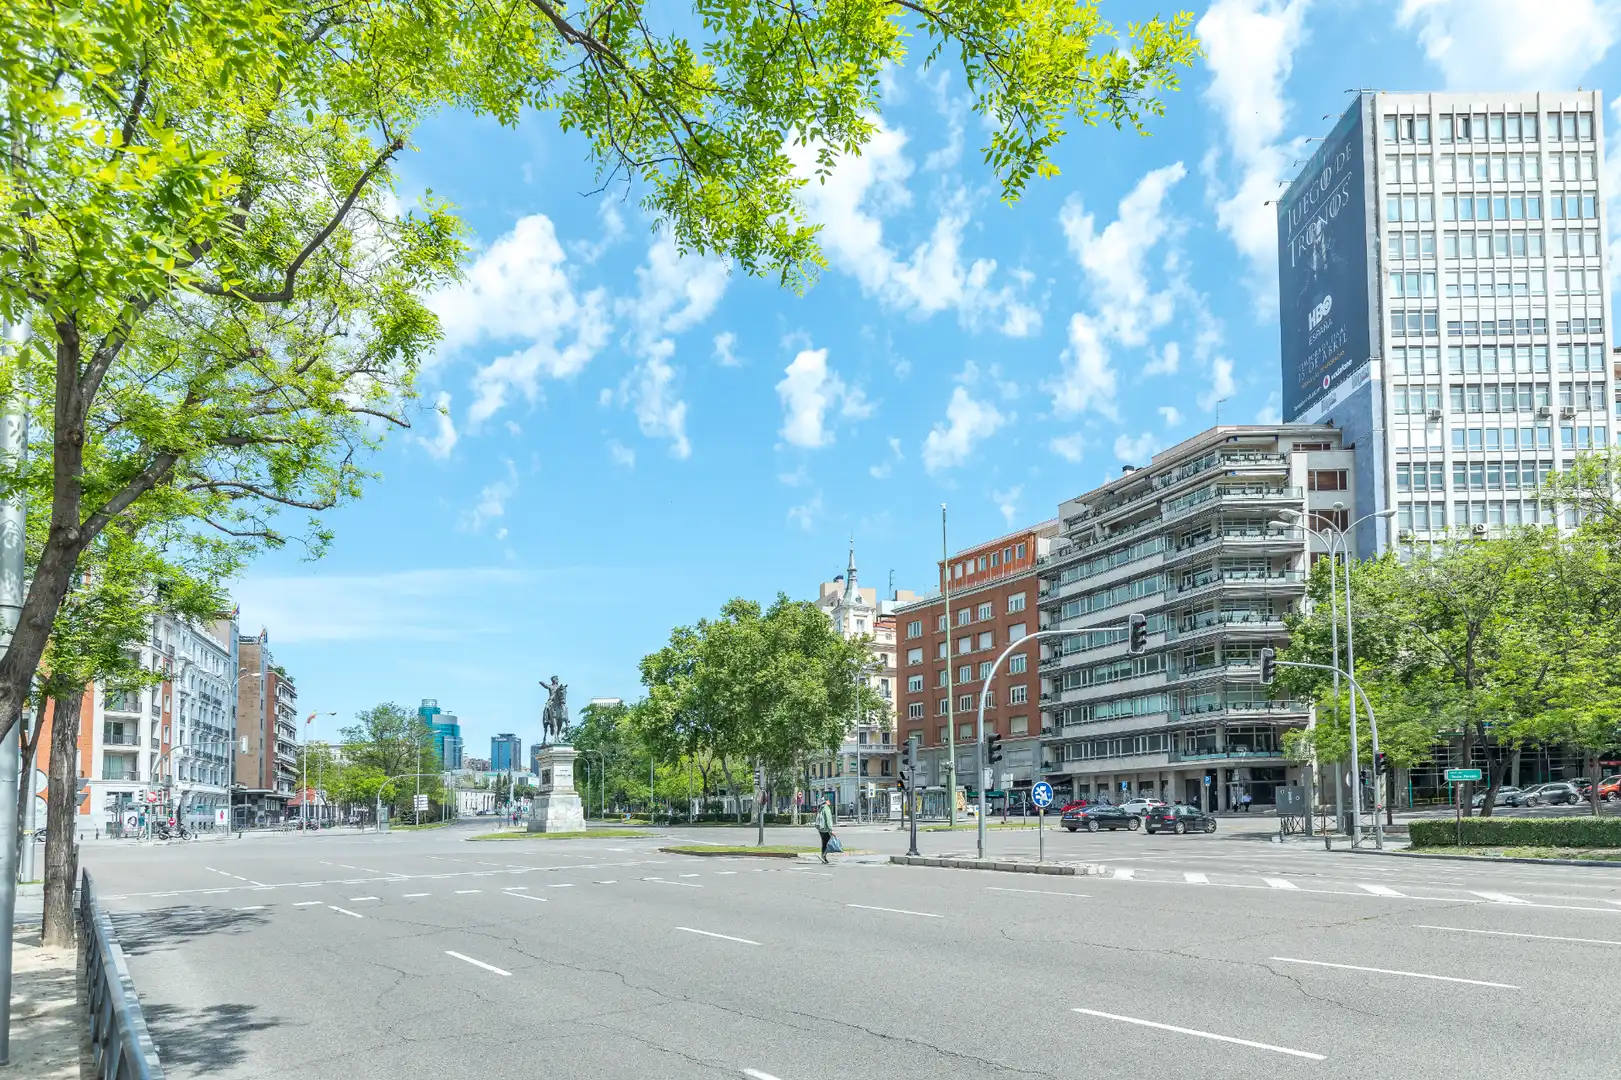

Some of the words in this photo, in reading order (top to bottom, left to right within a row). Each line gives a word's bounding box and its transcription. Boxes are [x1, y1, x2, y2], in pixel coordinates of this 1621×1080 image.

[1288, 167, 1332, 241] JUEGO
[1336, 142, 1352, 174] DE
[1288, 178, 1350, 267] TRONOS
[1308, 294, 1332, 331] HBO
[1309, 318, 1333, 346] ESPAÑA
